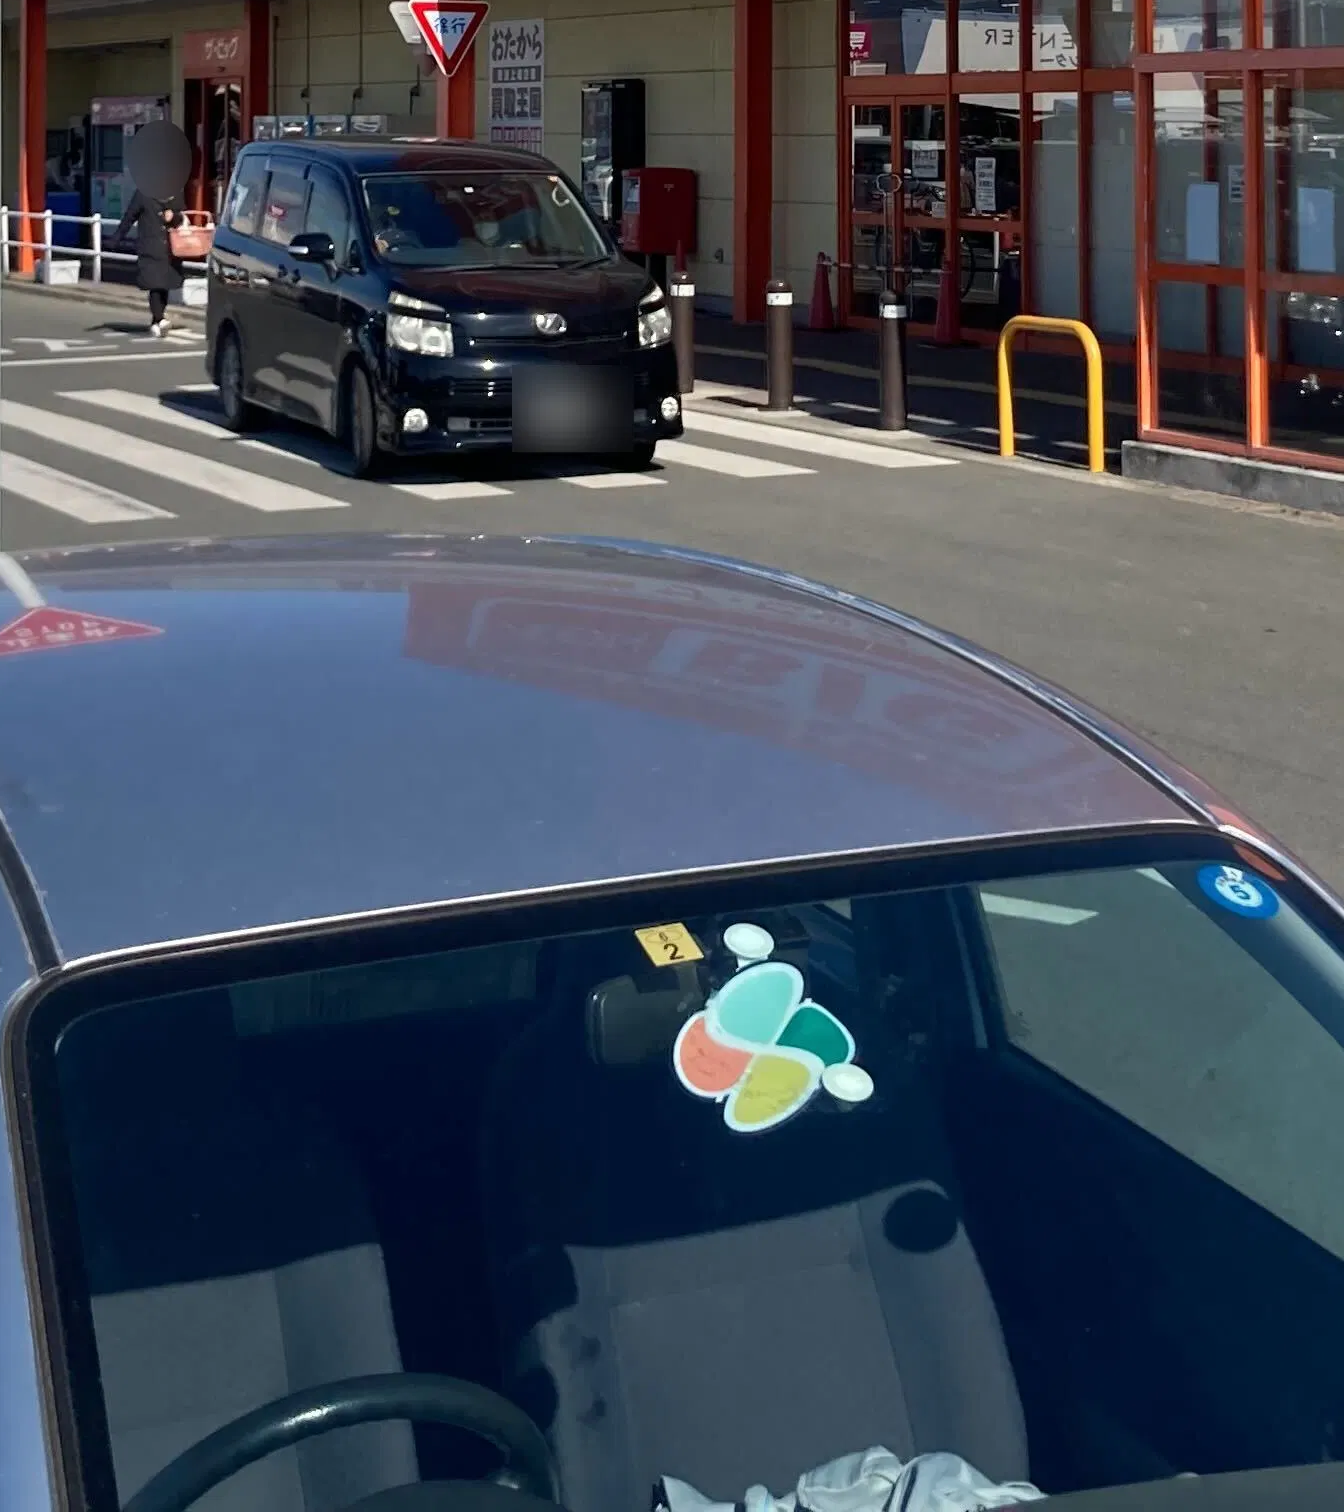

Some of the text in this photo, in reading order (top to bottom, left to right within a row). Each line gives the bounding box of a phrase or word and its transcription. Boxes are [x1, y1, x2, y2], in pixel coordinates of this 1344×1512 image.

[433, 16, 466, 35] 徐行
[491, 23, 543, 62] おたから
[663, 943, 685, 961] 2
